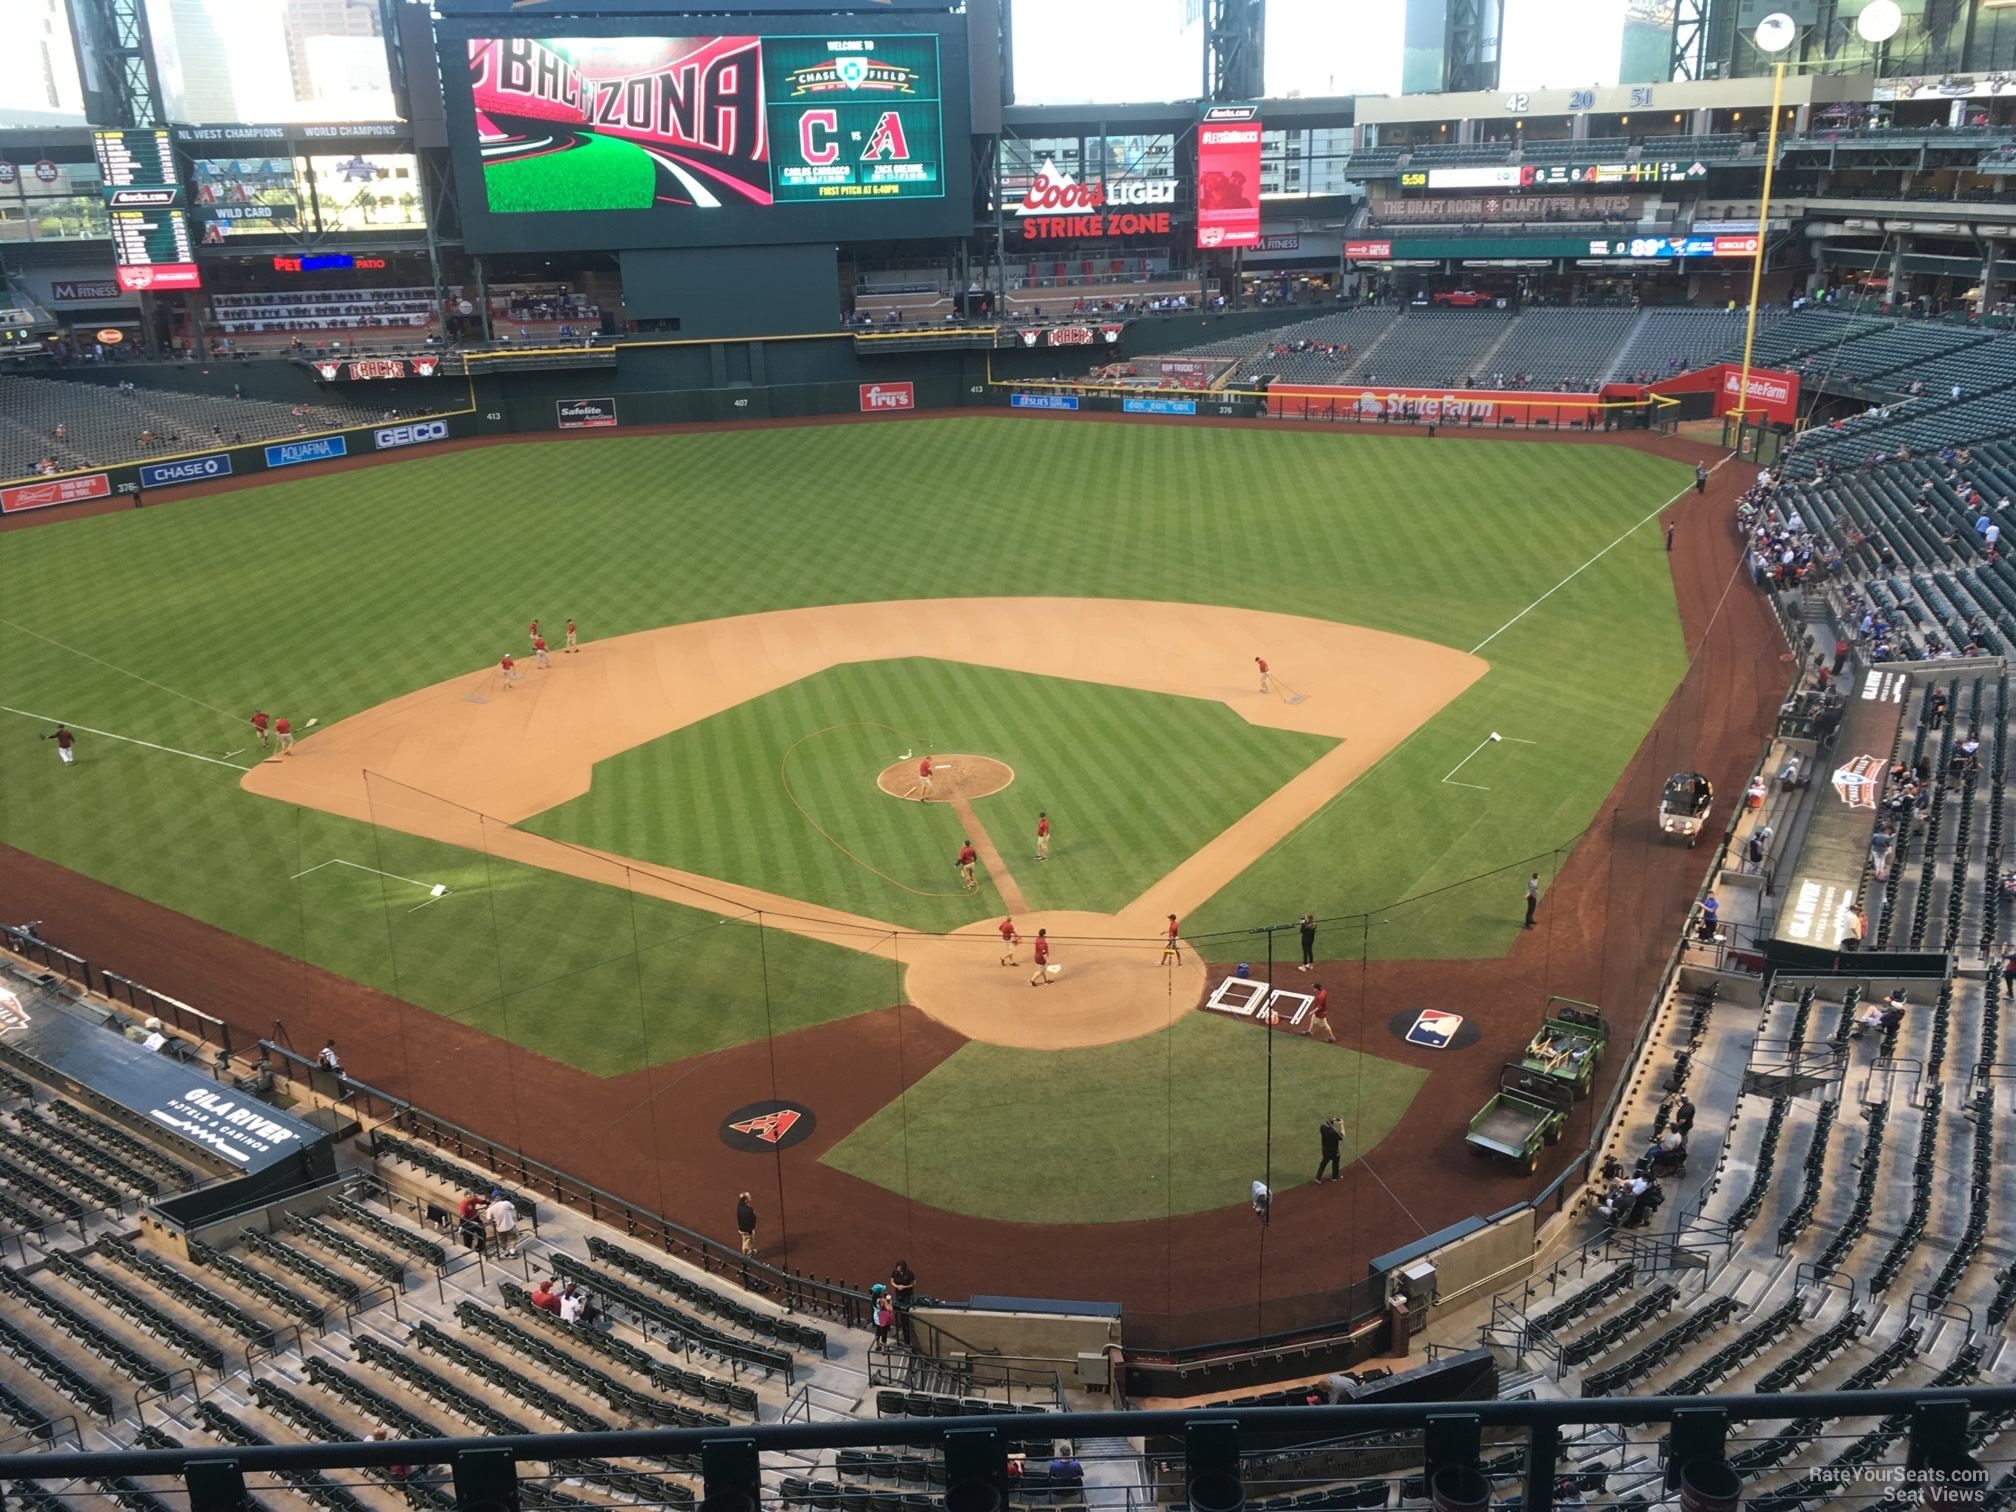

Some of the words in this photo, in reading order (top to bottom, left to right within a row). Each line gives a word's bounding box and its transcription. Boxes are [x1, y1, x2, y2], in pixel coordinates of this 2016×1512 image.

[827, 41, 863, 51] WELCOME
[864, 41, 874, 50] TO
[799, 70, 836, 83] CHASE
[869, 70, 906, 81] FIELD
[1505, 93, 1529, 112] 42
[1568, 91, 1595, 110] 20
[1630, 87, 1653, 107] 51
[178, 130, 193, 140] NL
[194, 129, 222, 139] WEST
[224, 127, 284, 139] CHAMPIONS
[304, 127, 337, 137] WORLD
[339, 125, 396, 136] CHAMPIONS
[799, 109, 839, 165] C
[851, 131, 862, 141] VS
[860, 112, 910, 160] A
[1402, 174, 1426, 185] 5:58
[1520, 165, 1534, 185] C
[1536, 170, 1545, 181] 6
[1571, 168, 1581, 181] 6
[819, 186, 839, 196] FIRST
[841, 185, 862, 195] PITCH
[863, 185, 872, 195] AT
[1023, 174, 1105, 210] Coors
[1106, 179, 1180, 206] LIGHT
[1383, 202, 1406, 214] THE
[1407, 200, 1446, 214] DRAFT
[1447, 199, 1482, 213] ROOM
[1502, 198, 1542, 212] CRAFT
[1578, 197, 1590, 209] &
[216, 208, 243, 218] WILD
[244, 207, 273, 217] CARD
[1023, 215, 1103, 239] STRIKE
[1107, 212, 1170, 236] ZONE
[1267, 240, 1298, 249] FITNESS
[1616, 242, 1625, 253] 0
[356, 259, 385, 269] PATIO
[77, 285, 118, 298] FITNESS
[970, 385, 984, 393] 413
[1763, 382, 1787, 400] Farm
[866, 386, 909, 407] fry's
[734, 399, 748, 408] 407
[1218, 406, 1233, 414] 376
[1387, 393, 1439, 416] State
[1441, 395, 1494, 417] Farm
[486, 412, 501, 421] 413
[561, 406, 601, 416] Safelite
[376, 421, 446, 448] GEICO
[280, 441, 334, 461] AQUAFINA
[154, 462, 204, 481] CHASE
[59, 482, 75, 491] THIS
[117, 483, 134, 494] 376
[61, 491, 74, 499] FOR
[1854, 760, 1870, 774] FIELD
[1849, 784, 1860, 801] CHASE
[1795, 884, 1822, 913] RIVER
[1788, 912, 1814, 938] GILA
[184, 1088, 235, 1117] GILA
[225, 1108, 293, 1145] RIVER
[166, 1099, 210, 1122] HOTELS
[219, 1126, 270, 1153] CASINOS
